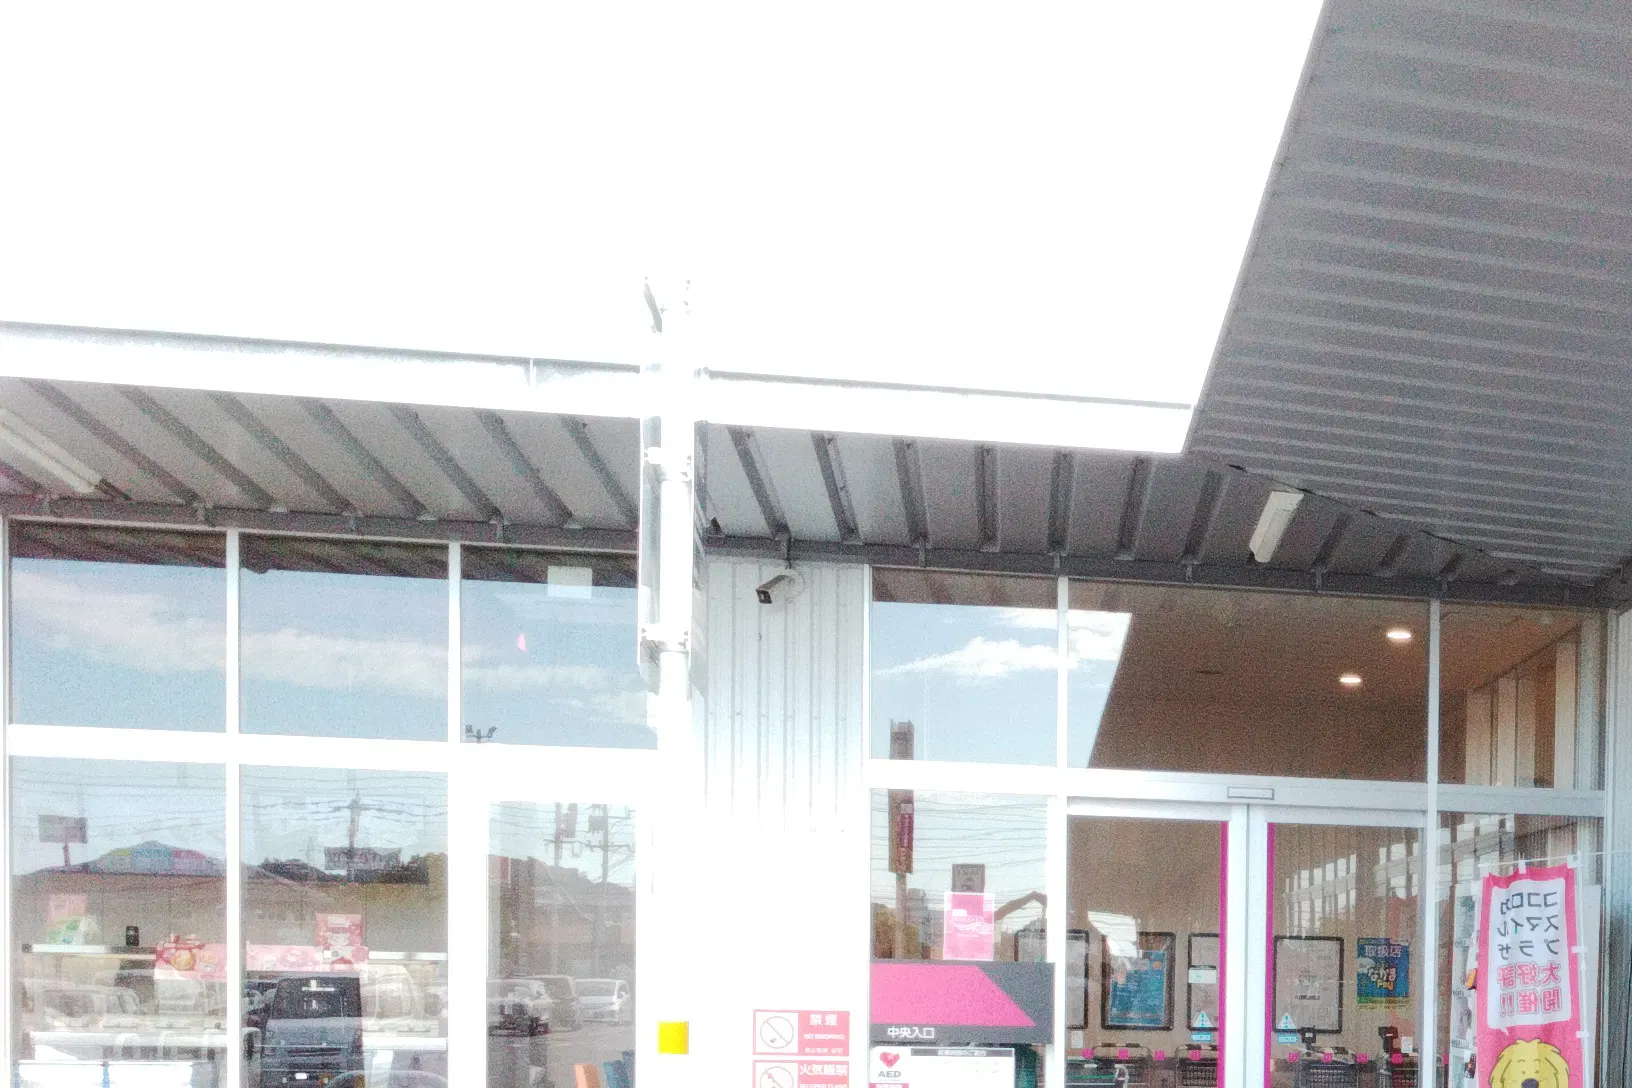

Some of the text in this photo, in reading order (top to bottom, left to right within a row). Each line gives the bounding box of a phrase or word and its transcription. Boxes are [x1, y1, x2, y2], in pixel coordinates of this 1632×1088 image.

[1364, 945, 1401, 957] 取扱店
[809, 1013, 838, 1026] 禁煙
[887, 1026, 935, 1038] 中央入口
[877, 1070, 902, 1078] AED
